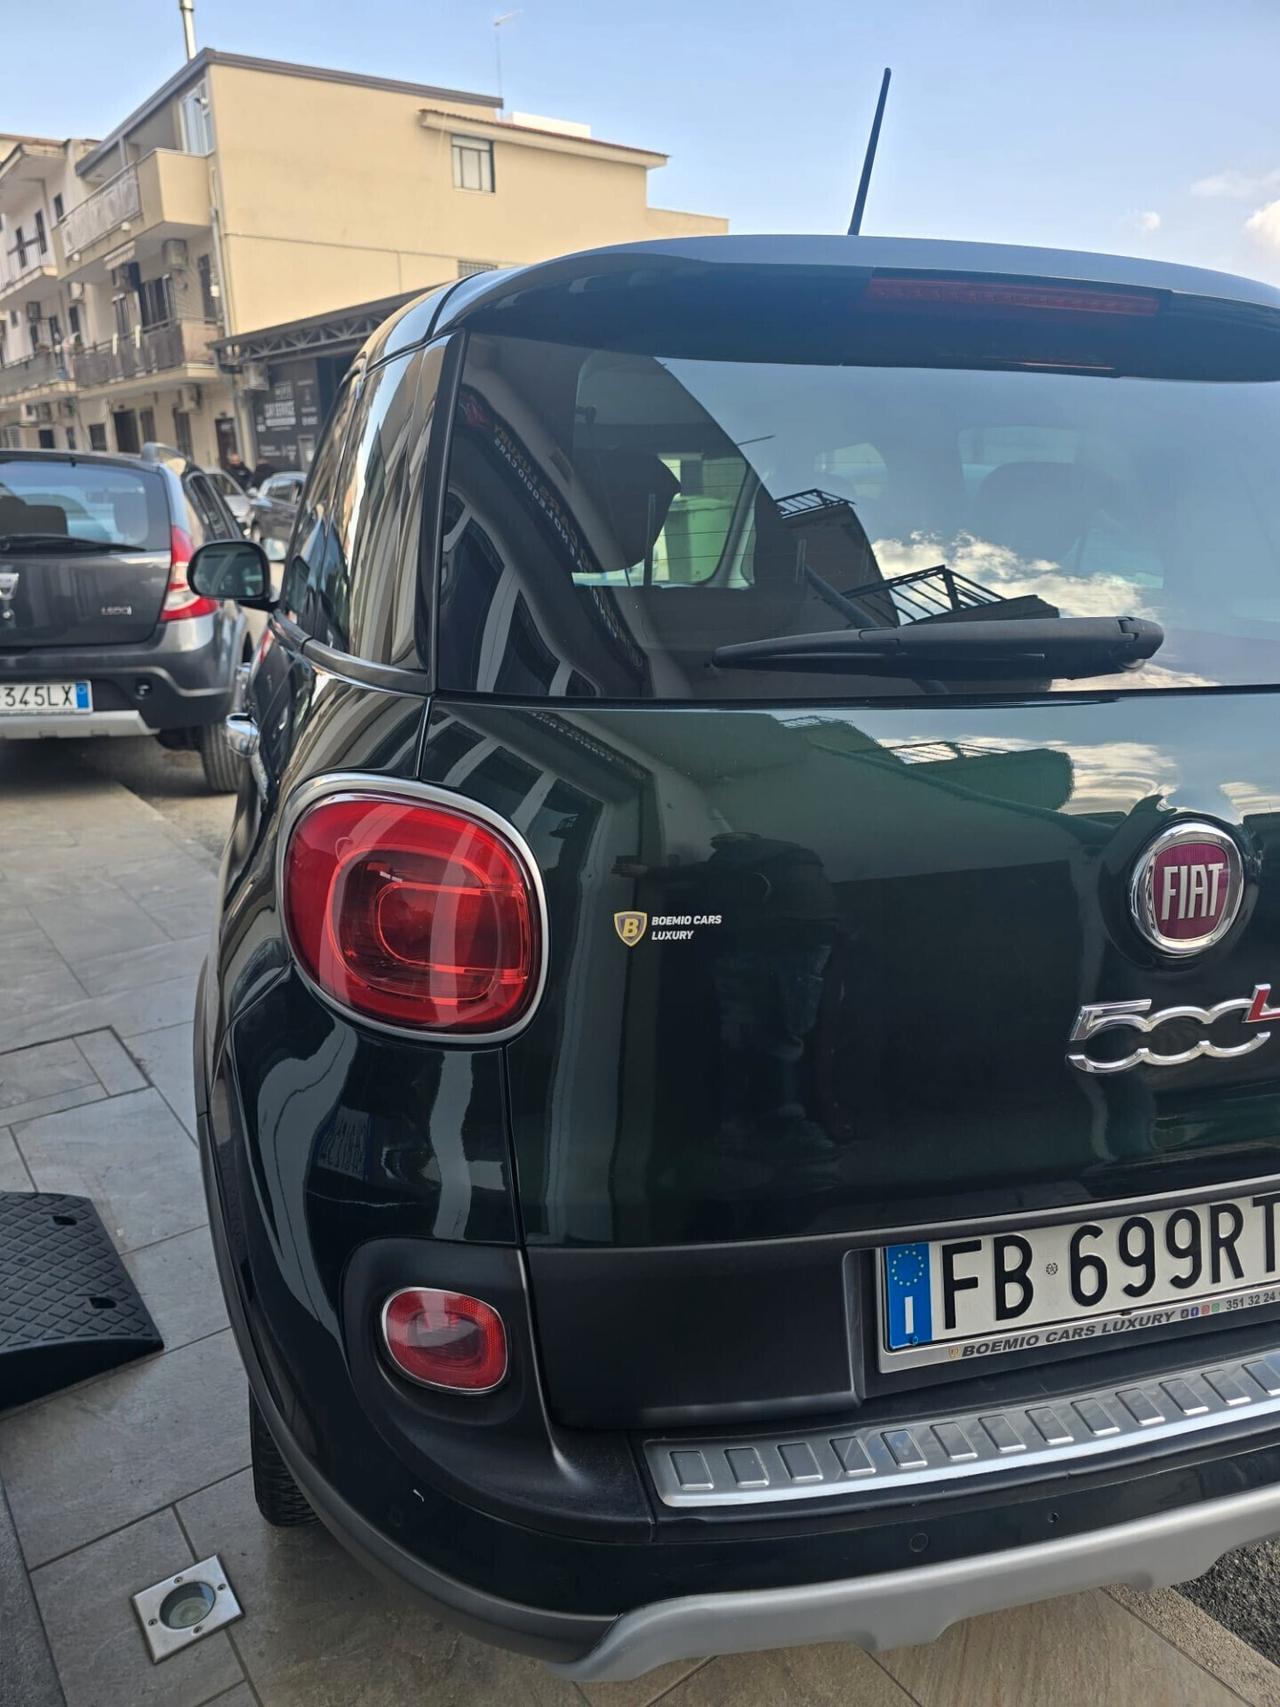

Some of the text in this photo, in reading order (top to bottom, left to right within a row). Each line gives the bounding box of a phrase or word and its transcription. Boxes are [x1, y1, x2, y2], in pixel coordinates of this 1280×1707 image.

[4, 686, 73, 706] 345LX
[1161, 863, 1224, 920] FIAT
[622, 918, 639, 937] B
[652, 915, 722, 926] BOEMIO CARS
[651, 930, 694, 940] LUXURY
[941, 1234, 1034, 1330] FB
[961, 1291, 1276, 1358] BOEMIO CARS LUXURY 351 32 24
